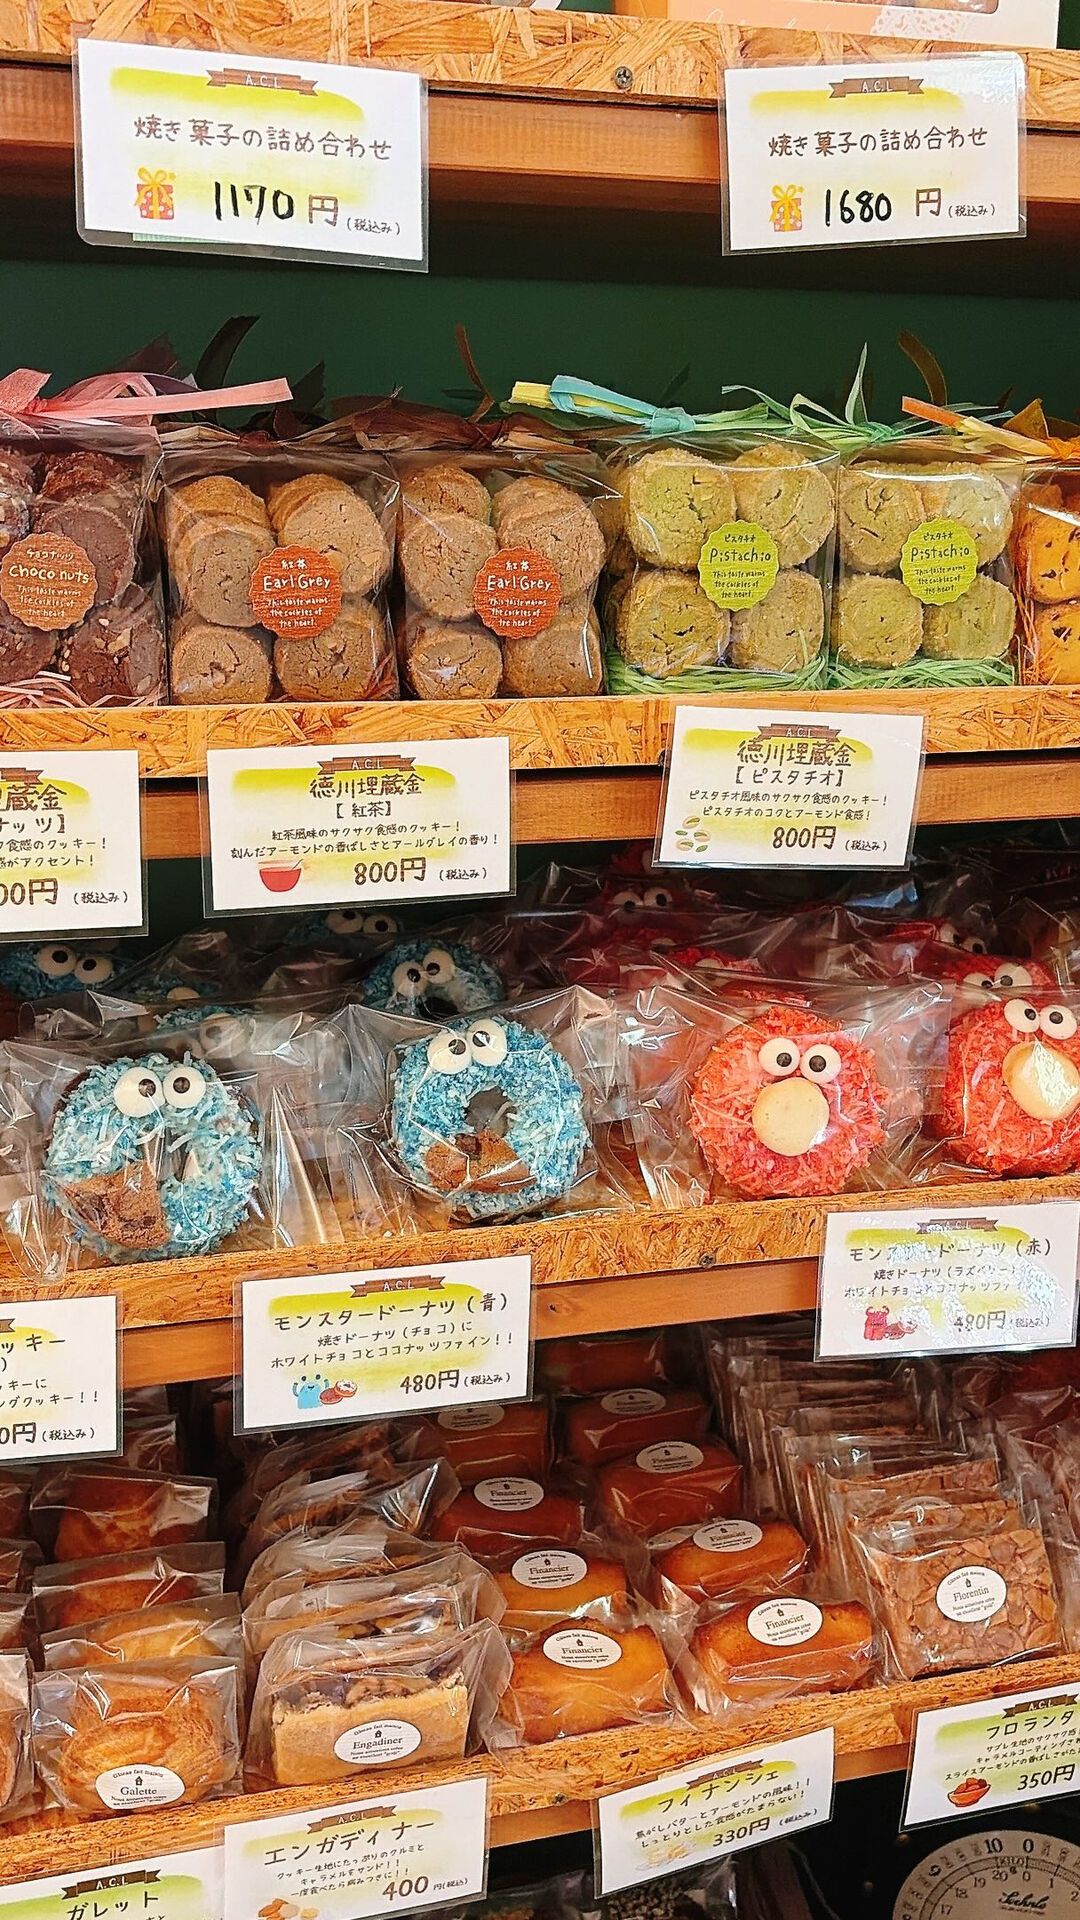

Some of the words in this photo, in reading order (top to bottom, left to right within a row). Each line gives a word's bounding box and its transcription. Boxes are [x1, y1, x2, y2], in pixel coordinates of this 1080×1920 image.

[214, 180, 295, 225] 1170
[825, 188, 892, 227] 1680
[710, 547, 771, 563] Pistachio
[911, 543, 970, 562] Pistachio
[9, 564, 55, 580] Choco
[60, 569, 89, 584] nuts
[263, 575, 294, 591] Earl
[298, 574, 330, 589] Grey
[487, 575, 516, 590] Earl
[520, 576, 551, 591] Grey
[737, 740, 857, 767] 徳川埋蔵金
[309, 773, 426, 799] 徳川埋蔵金
[0, 837, 107, 853] 食感のクッキー！
[772, 825, 837, 850] 800円
[353, 856, 426, 886] 800円
[849, 1238, 1051, 1262] モンドーナツ（赤）
[0, 1378, 47, 1391] キーに
[400, 1369, 460, 1395] 480円
[529, 1565, 570, 1575] Financier
[953, 1586, 990, 1602] Florentin
[765, 1614, 805, 1630] Financier
[561, 1646, 604, 1655] Financier
[986, 1710, 1074, 1739] フロランタ
[352, 1737, 403, 1749] Engadiner
[1017, 1764, 1075, 1790] 350円
[120, 1786, 158, 1796] Galette
[658, 1770, 780, 1813] フィナンシェ
[713, 1816, 770, 1847] 330円
[264, 1821, 434, 1865] エンガディナー
[984, 1838, 1003, 1854] 10
[1023, 1839, 1034, 1853] 0
[992, 1870, 1008, 1881] 20
[1022, 1871, 1031, 1881] 0
[381, 1876, 429, 1901] 400
[67, 1891, 158, 1920] ガレット
[941, 1904, 953, 1915] 17
